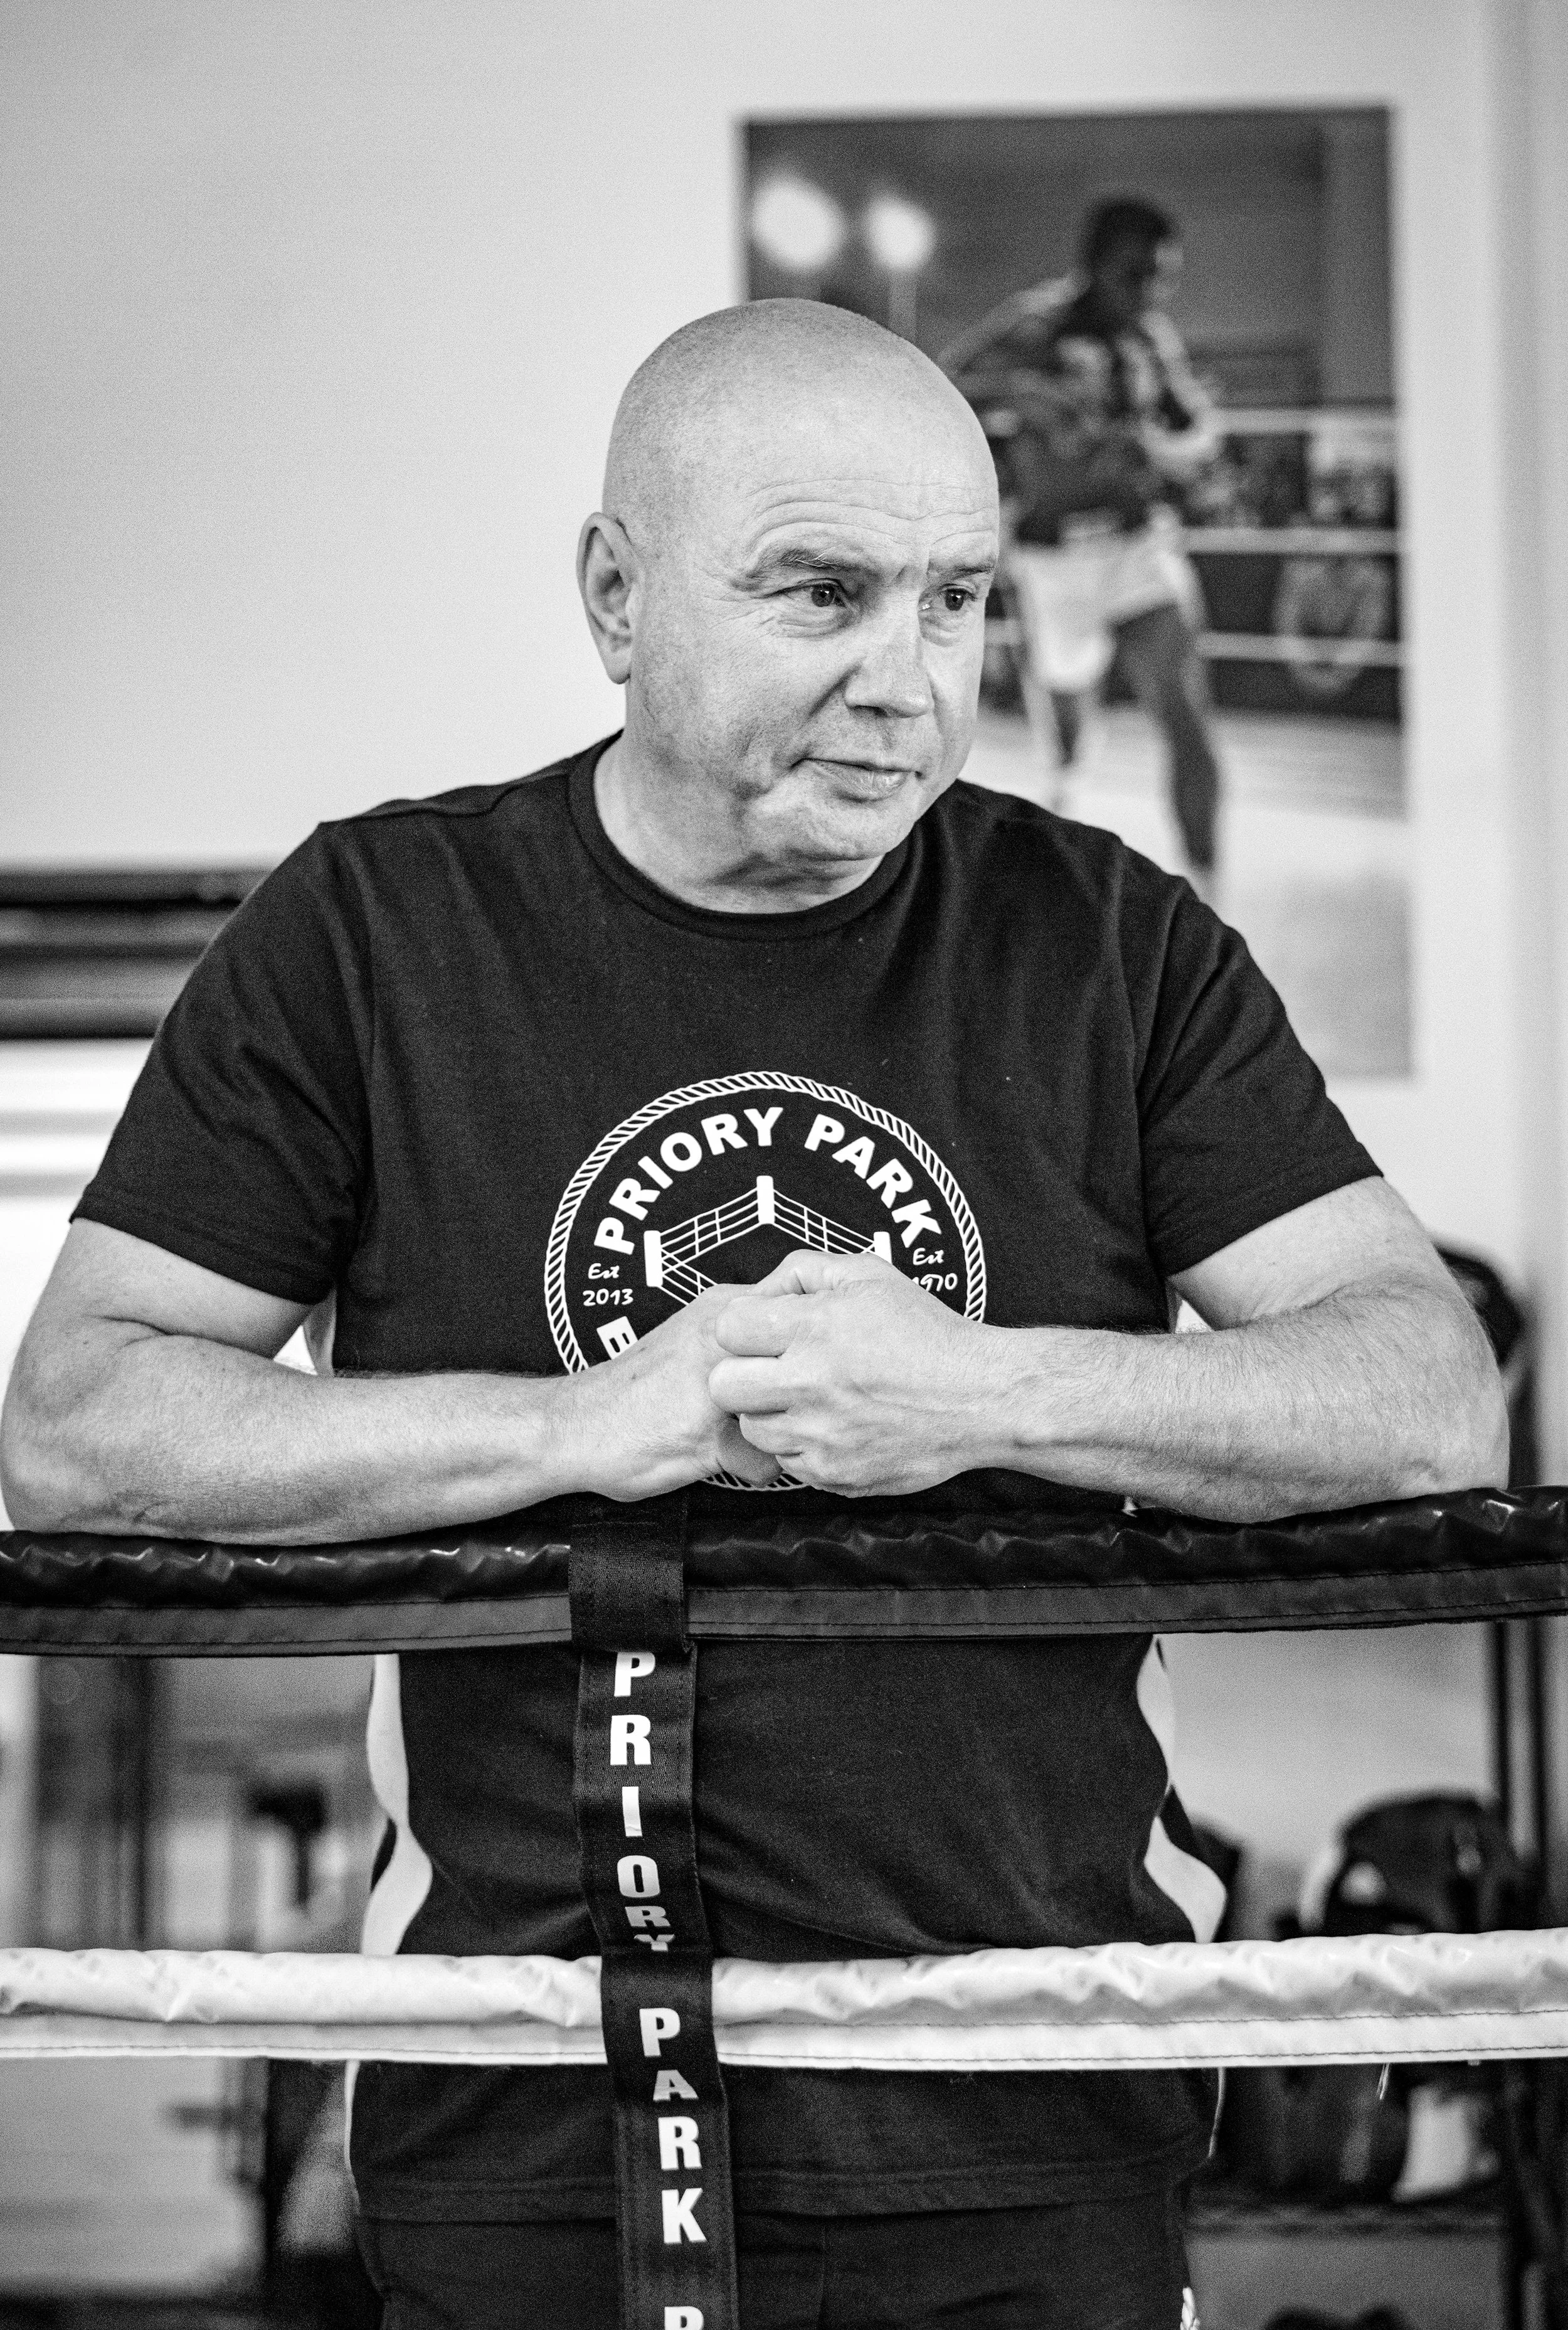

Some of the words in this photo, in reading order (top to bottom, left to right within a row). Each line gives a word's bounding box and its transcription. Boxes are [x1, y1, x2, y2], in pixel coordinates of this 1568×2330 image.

[593, 1107, 784, 1255] PRIORY
[804, 1114, 941, 1248] PARK
[582, 1288, 633, 1307] 2013
[588, 1262, 620, 1280] Est
[913, 1247, 944, 1265] Est
[610, 1651, 674, 1952] PRIORY
[639, 2008, 707, 2245] PARK
